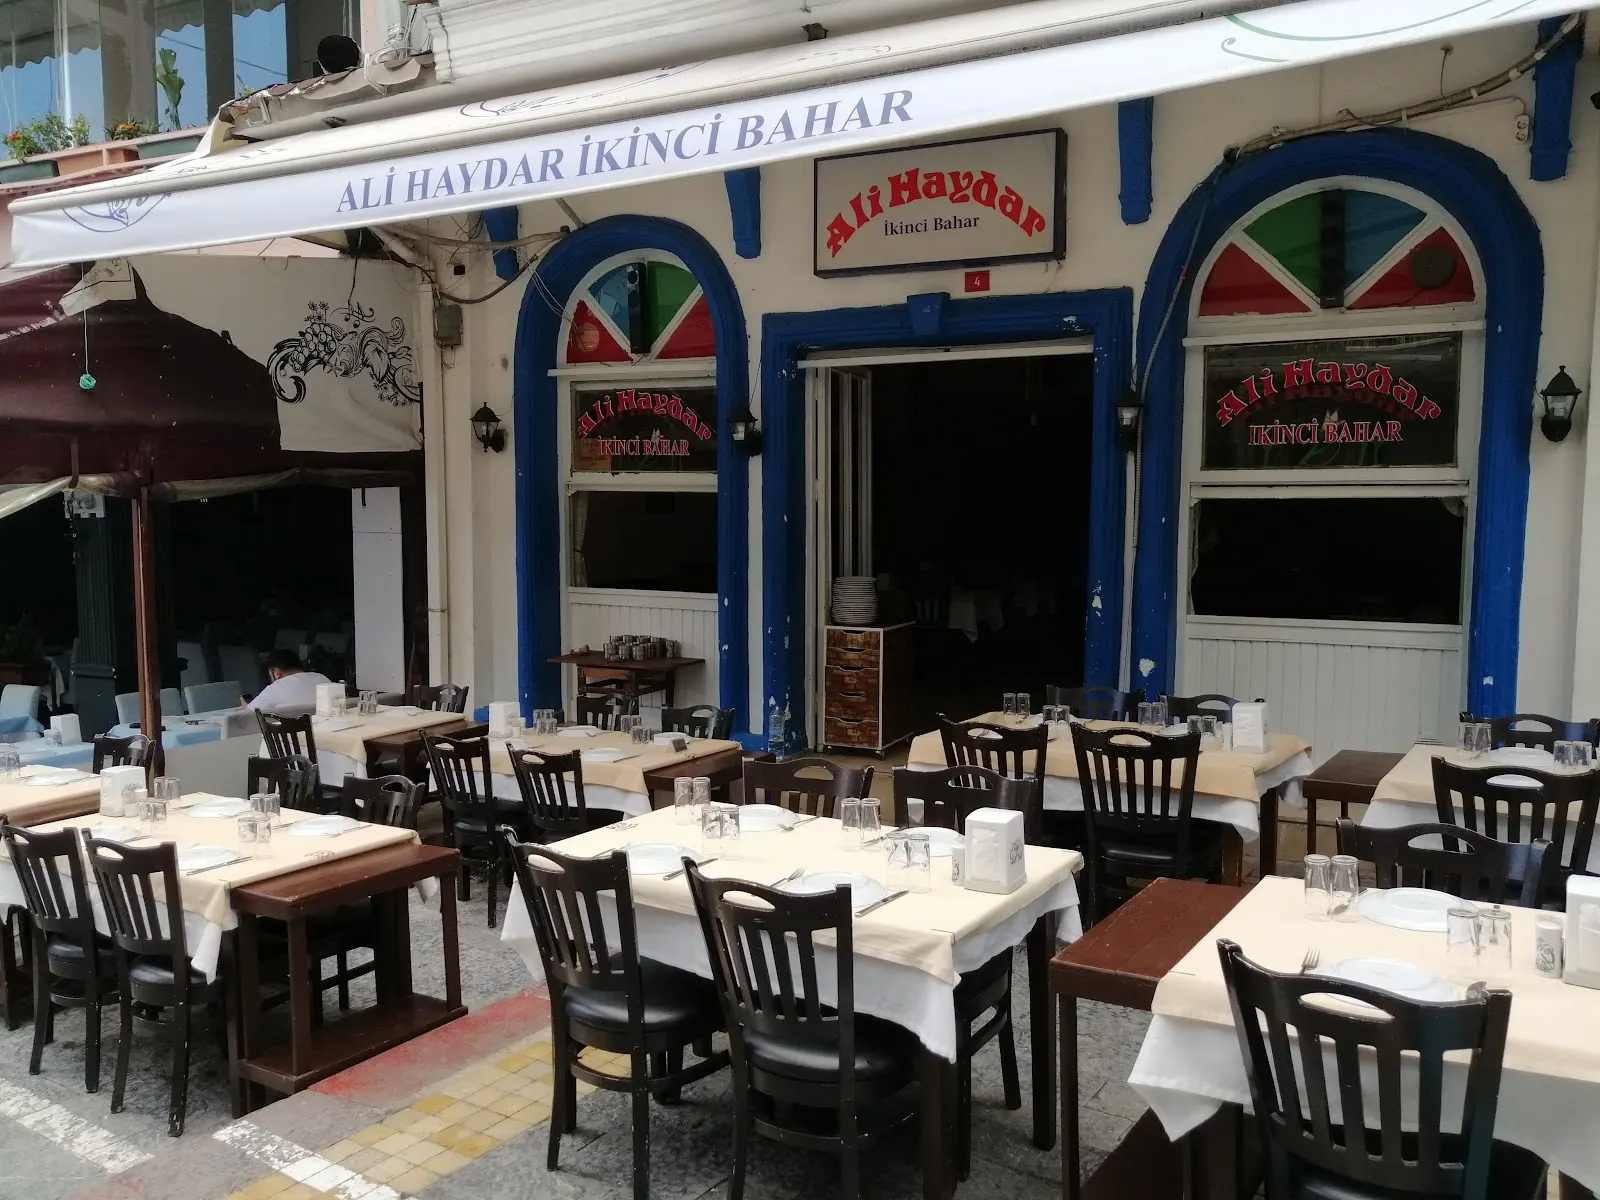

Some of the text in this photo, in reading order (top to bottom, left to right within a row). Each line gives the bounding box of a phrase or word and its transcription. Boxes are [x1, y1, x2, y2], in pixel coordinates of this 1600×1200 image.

[336, 89, 913, 212] ALİ HAYDAR İKİNCİ BAHAR
[826, 167, 1047, 259] Ali Haydar
[884, 215, 980, 237] İkinci Bahar
[973, 275, 982, 288] 4
[1215, 357, 1443, 428] Ali Haydar
[577, 389, 712, 440] Ali Haydar
[1323, 420, 1404, 444] BAHAR
[642, 439, 690, 456] BAHAR
